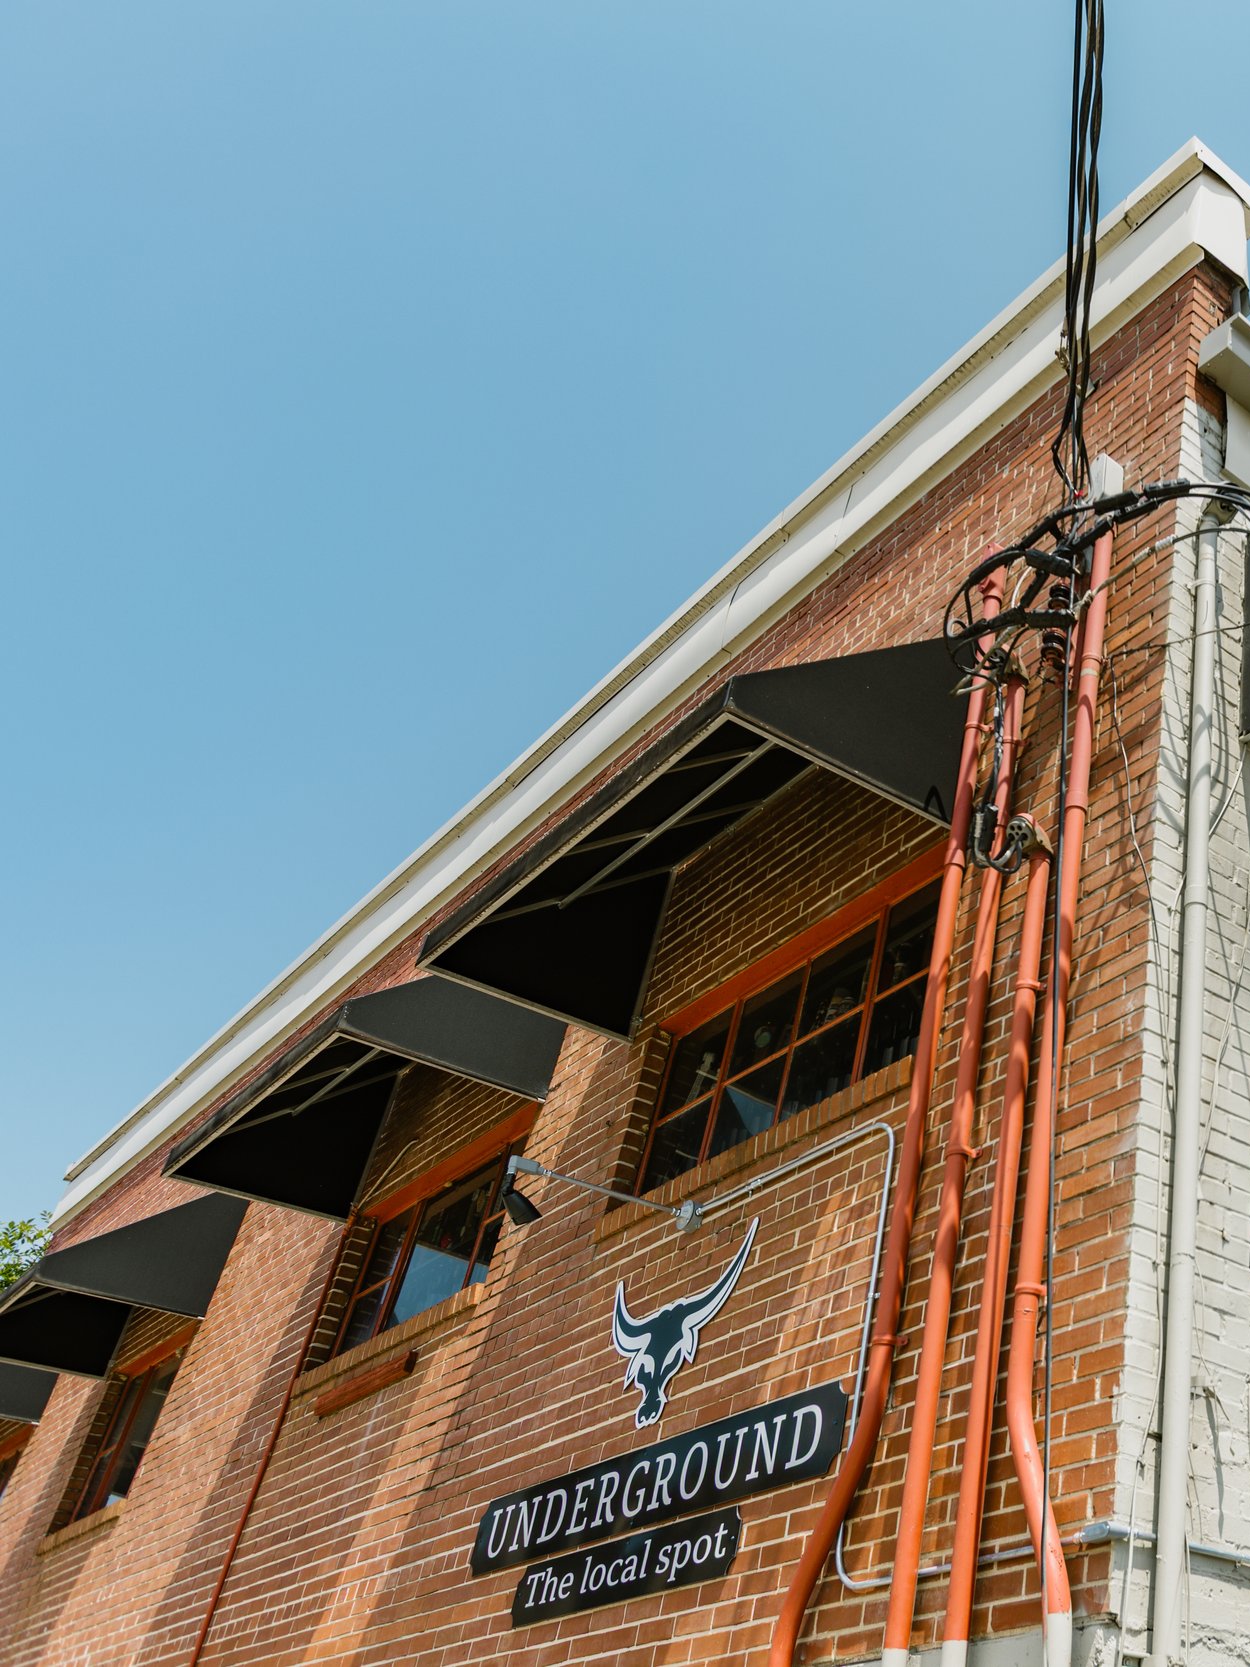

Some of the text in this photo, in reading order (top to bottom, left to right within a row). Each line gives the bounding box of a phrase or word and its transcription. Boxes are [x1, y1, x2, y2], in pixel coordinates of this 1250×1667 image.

[486, 1403, 824, 1559] UNDERGROUND
[523, 1522, 729, 1609] The local spot
